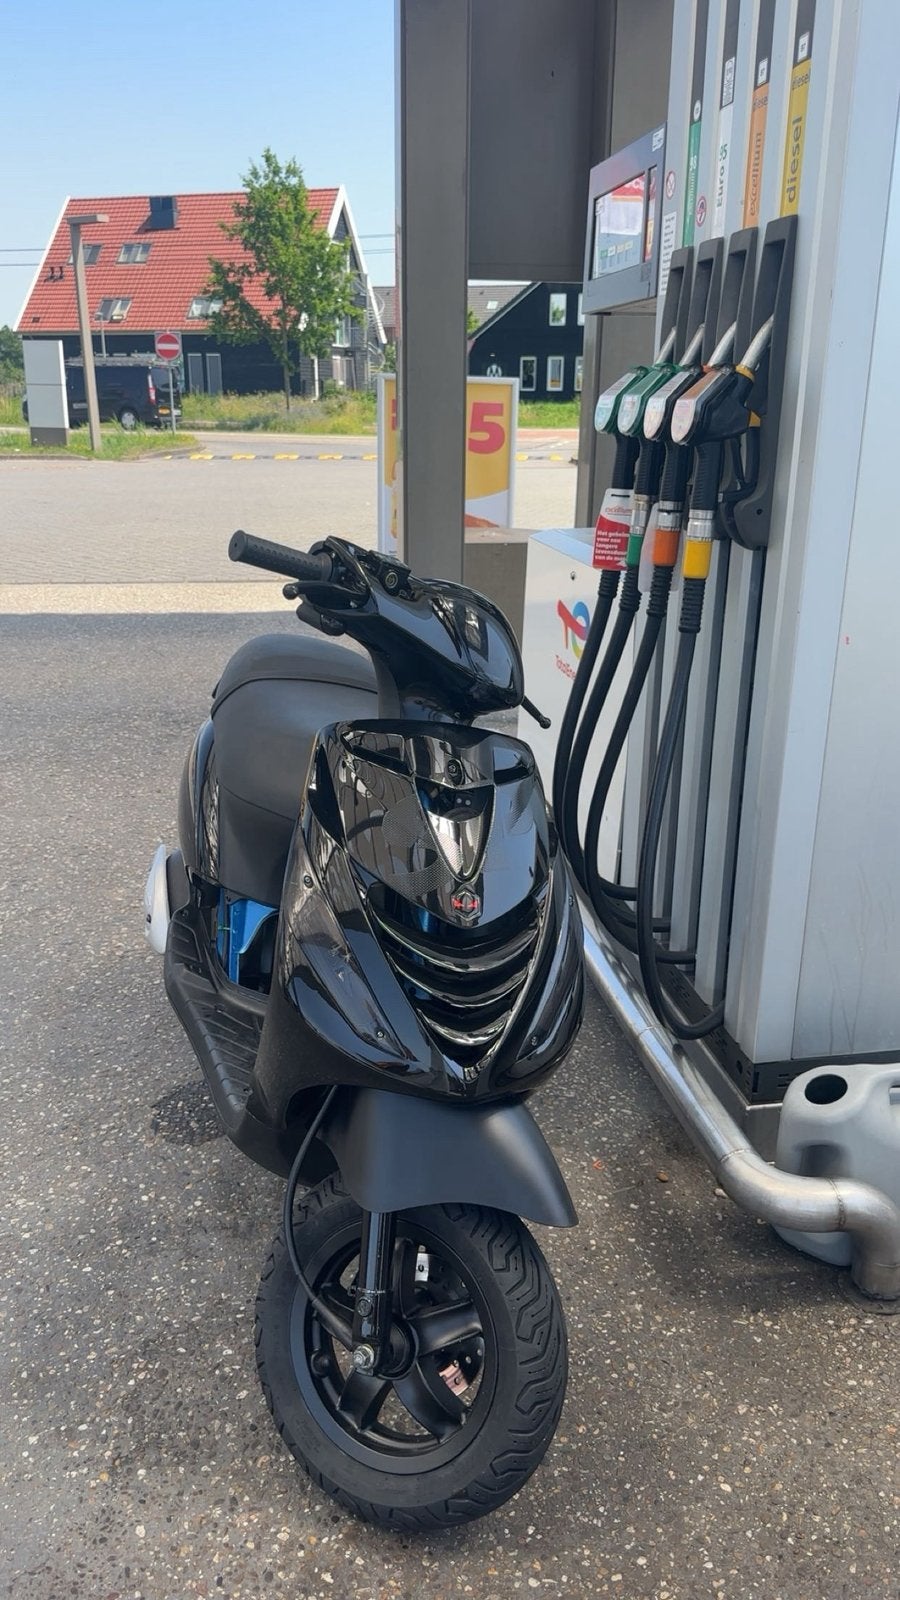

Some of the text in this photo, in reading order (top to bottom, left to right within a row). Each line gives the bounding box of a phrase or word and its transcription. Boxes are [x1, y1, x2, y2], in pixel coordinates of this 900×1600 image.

[716, 166, 725, 208] Euro
[750, 132, 762, 216] excellium
[786, 116, 802, 204] diesel
[468, 401, 506, 455] 5
